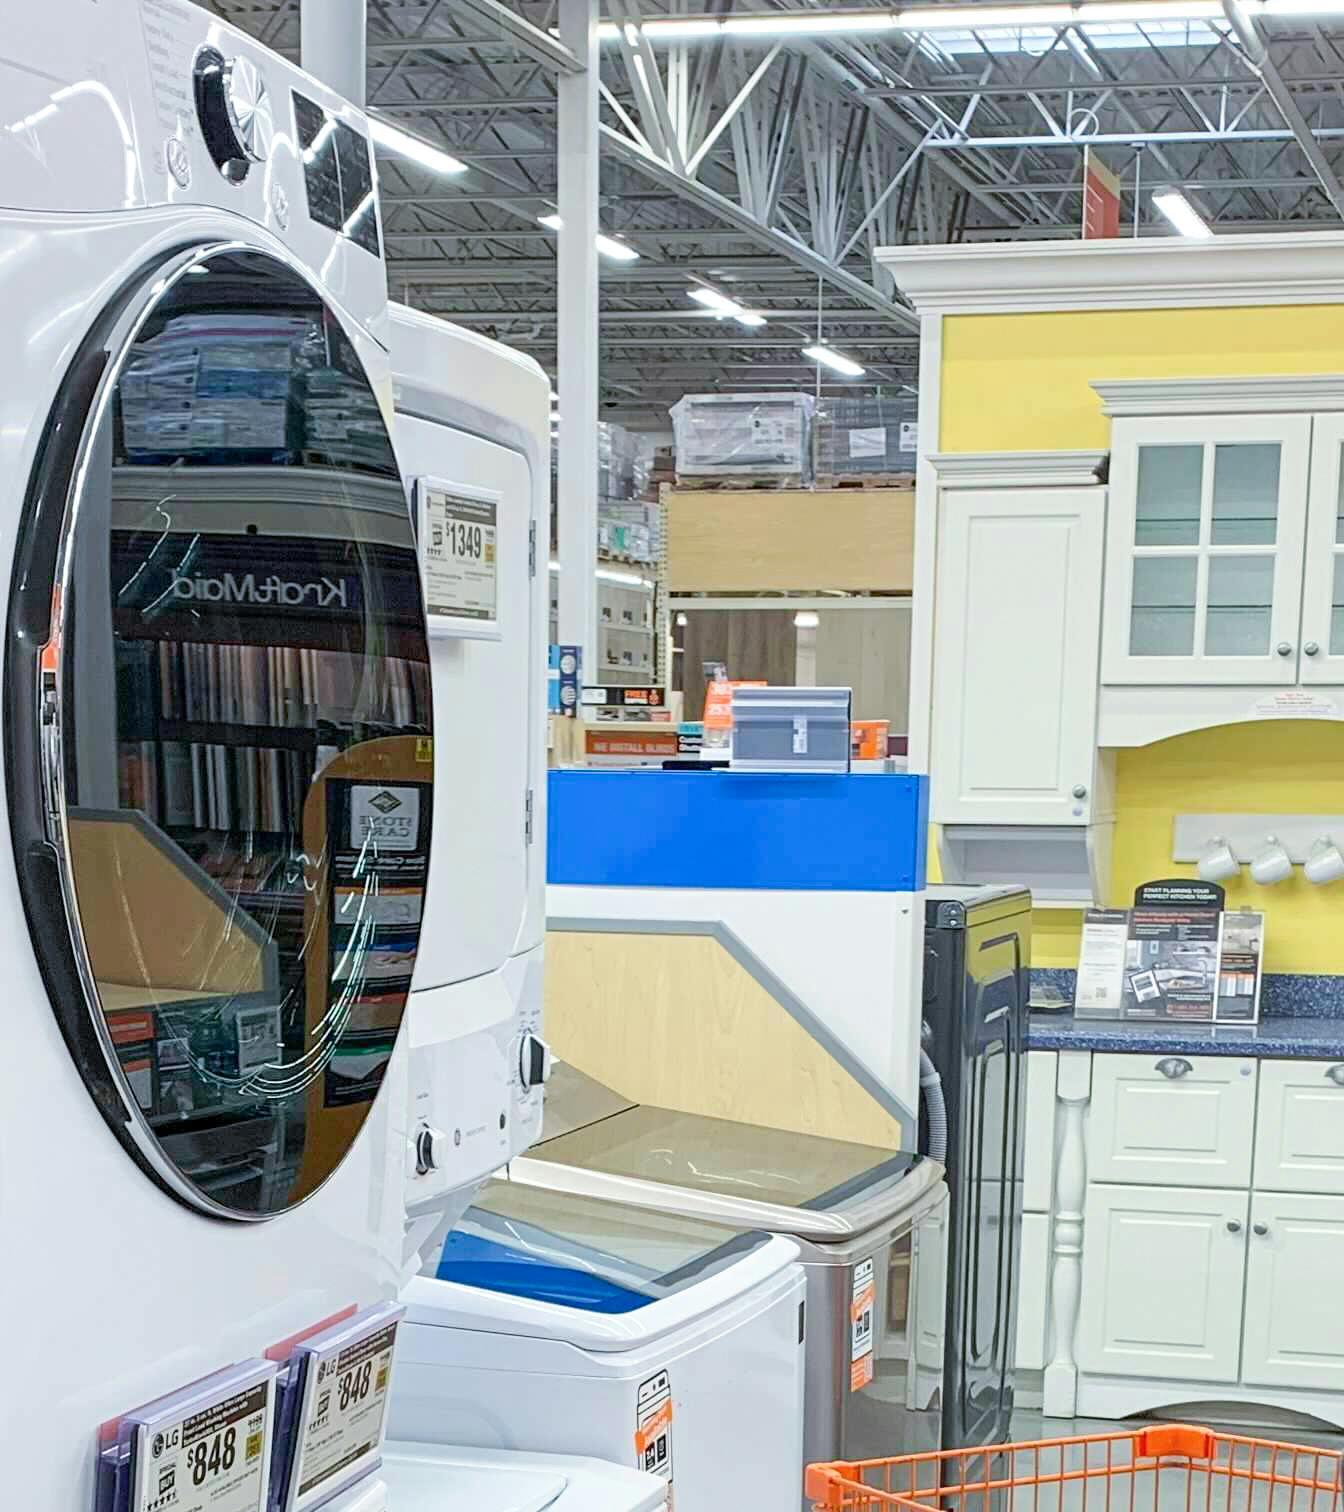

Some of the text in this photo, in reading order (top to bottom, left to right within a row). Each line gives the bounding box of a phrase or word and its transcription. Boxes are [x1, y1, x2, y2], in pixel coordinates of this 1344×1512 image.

[446, 522, 481, 559] $1349
[338, 1361, 372, 1411] $848
[165, 1428, 178, 1449] LG
[187, 1427, 236, 1486] $848
